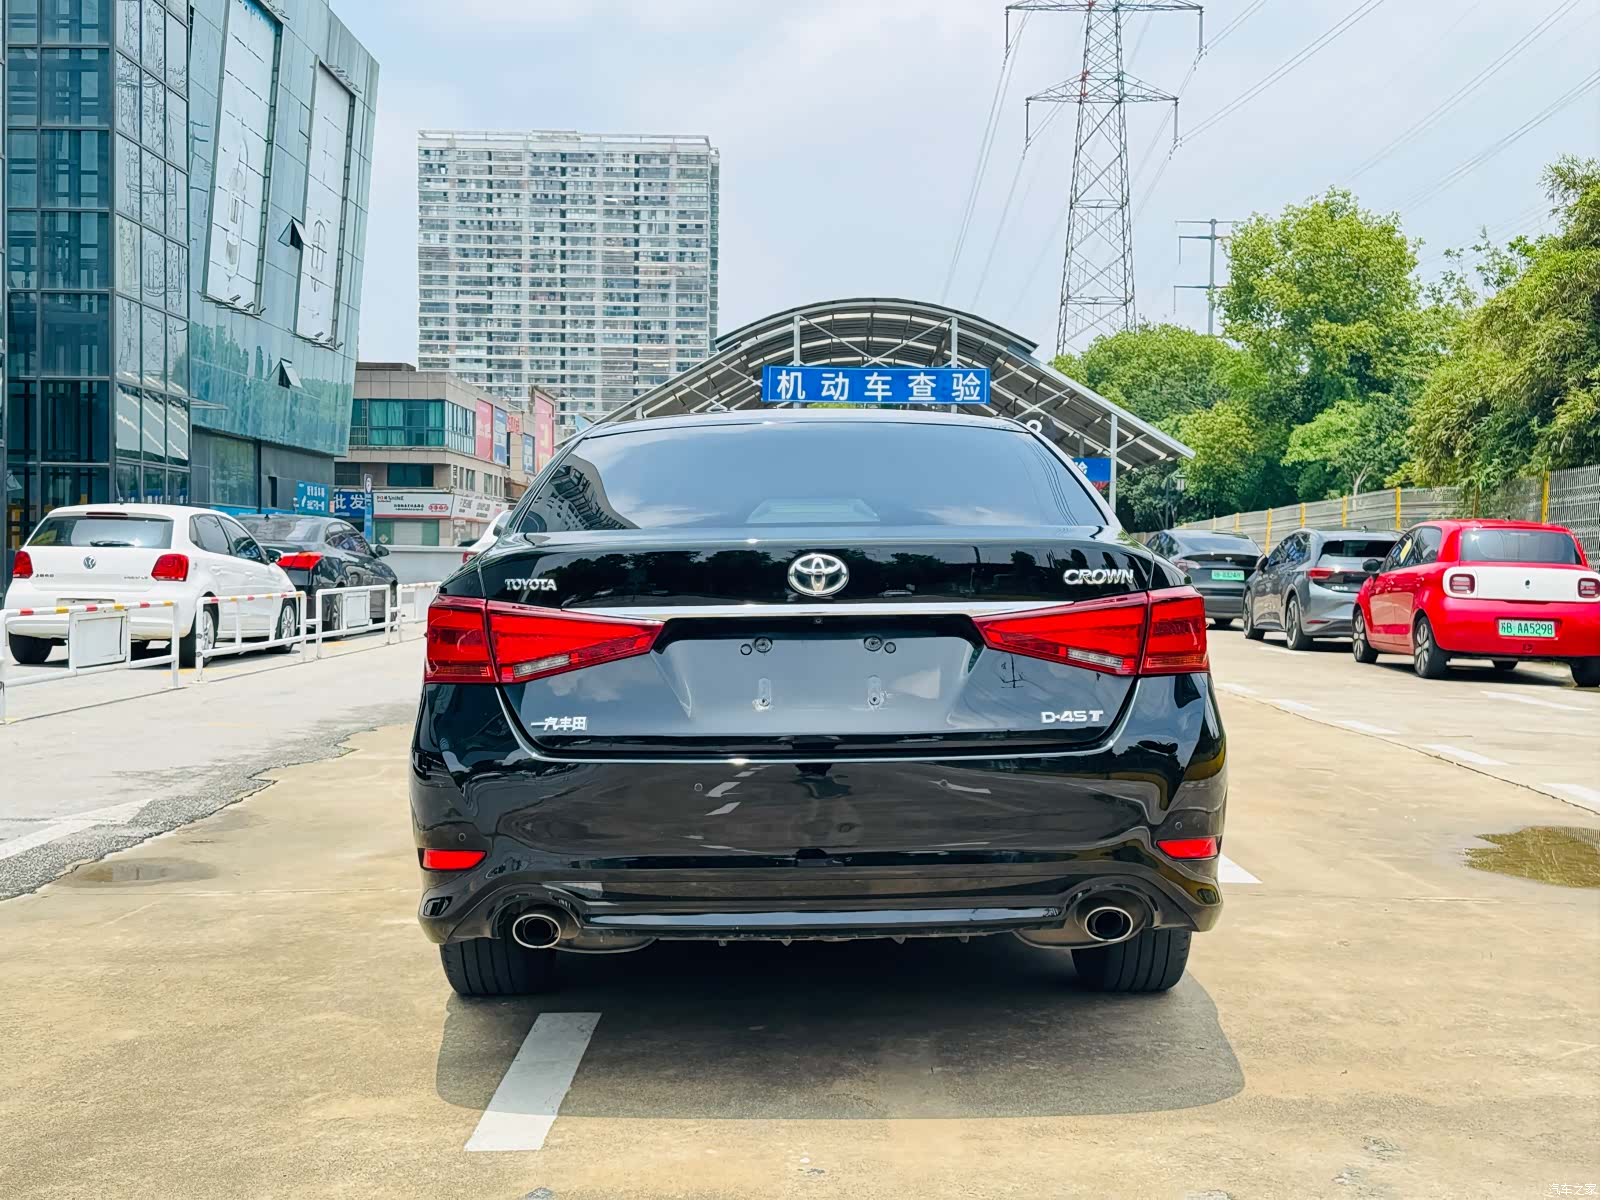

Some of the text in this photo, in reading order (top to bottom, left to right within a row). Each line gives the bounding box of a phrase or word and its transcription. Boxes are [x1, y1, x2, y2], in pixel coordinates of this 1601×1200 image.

[777, 370, 981, 401] 机动车查验
[333, 494, 366, 510] 批发
[504, 578, 558, 591] TOYOTA
[1063, 568, 1134, 585] CROWN
[530, 716, 587, 732] 一汽丰田
